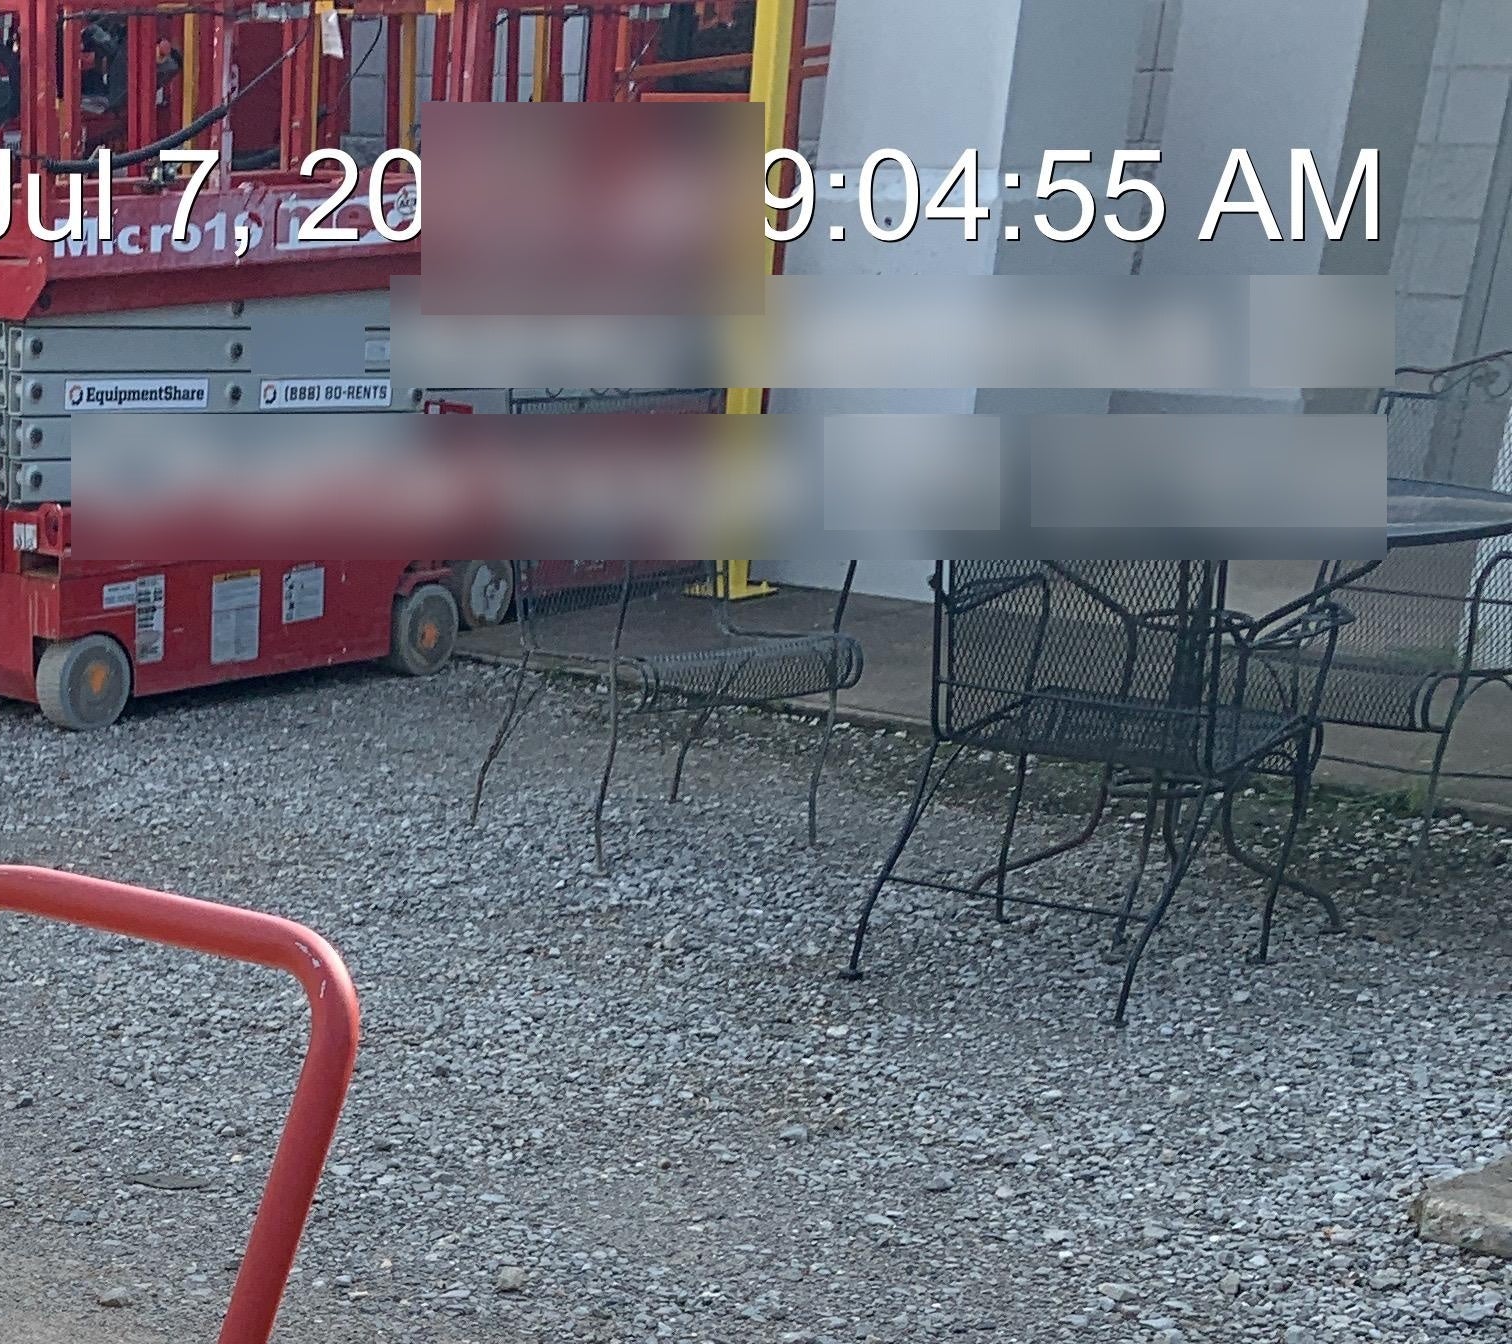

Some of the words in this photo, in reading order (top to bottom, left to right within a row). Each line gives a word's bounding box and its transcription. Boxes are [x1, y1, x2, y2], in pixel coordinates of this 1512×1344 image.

[85, 386, 206, 404] EquipmentShare
[284, 385, 321, 402] (888)
[324, 385, 388, 400] 80-RENTS
